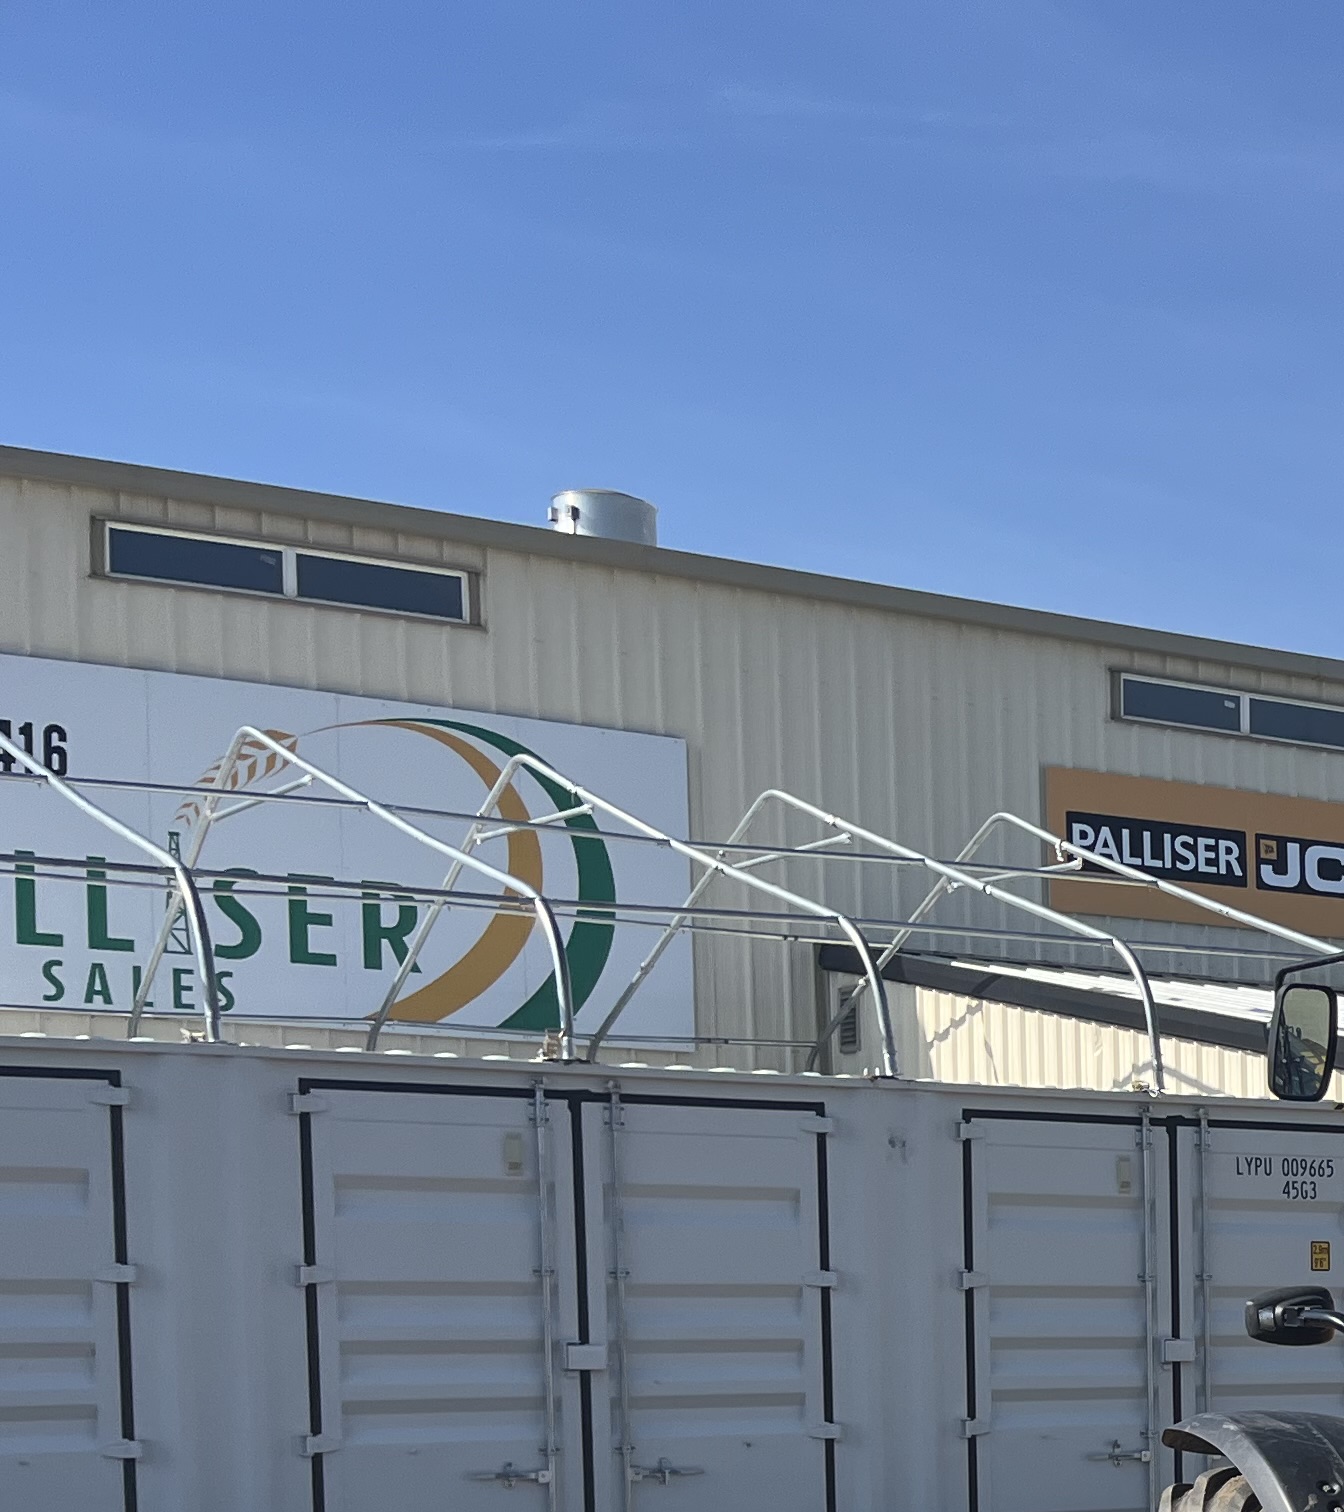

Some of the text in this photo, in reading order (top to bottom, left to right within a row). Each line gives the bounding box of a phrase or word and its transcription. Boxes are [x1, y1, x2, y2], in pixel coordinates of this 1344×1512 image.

[1072, 823, 1243, 877] PALLISER
[42, 959, 236, 1012] SALES
[1236, 1157, 1272, 1177] LYPU
[1282, 1157, 1334, 1178] 009665
[1282, 1181, 1317, 1200] 45G3
